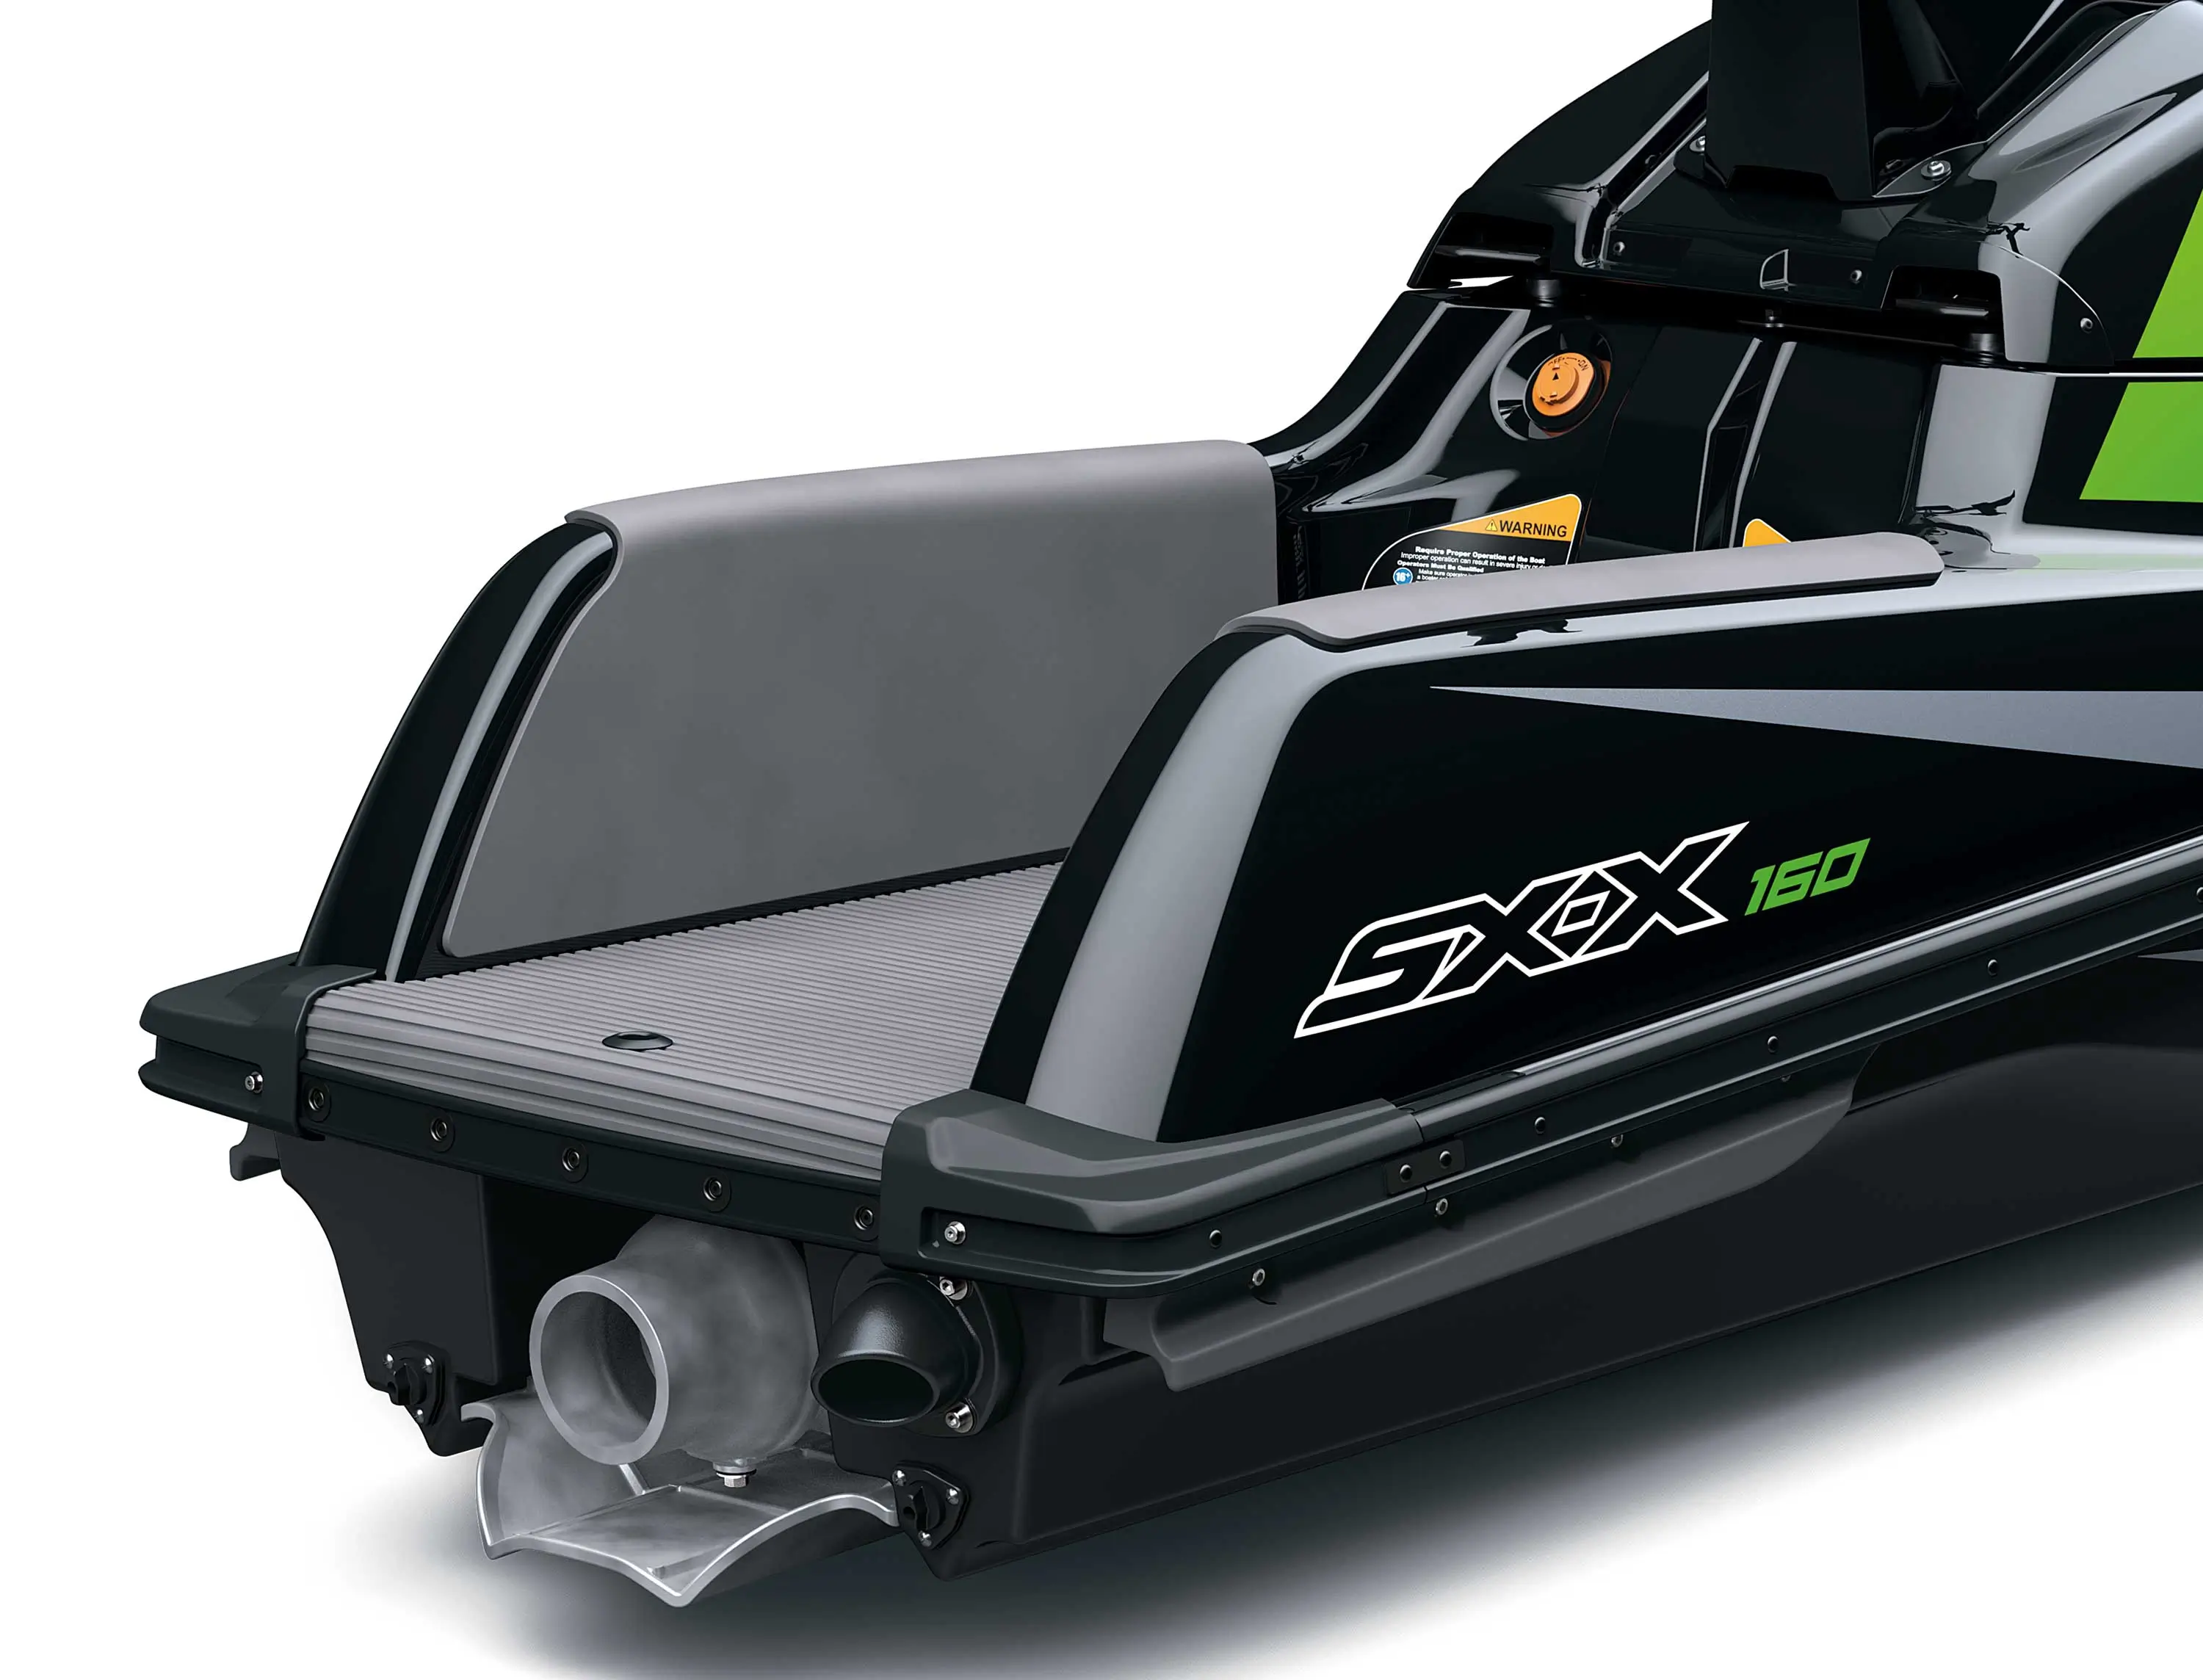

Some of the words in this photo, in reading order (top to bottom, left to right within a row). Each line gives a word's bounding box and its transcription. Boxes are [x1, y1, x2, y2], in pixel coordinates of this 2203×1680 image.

[1500, 520, 1567, 537] WARNING
[1416, 546, 1444, 554] Require
[1472, 551, 1507, 560] Operation
[1397, 560, 1429, 568] Operators
[1401, 552, 1429, 560] Improper
[1516, 562, 1532, 571] injury
[1396, 572, 1411, 582] 16+
[1744, 838, 1870, 916] 160
